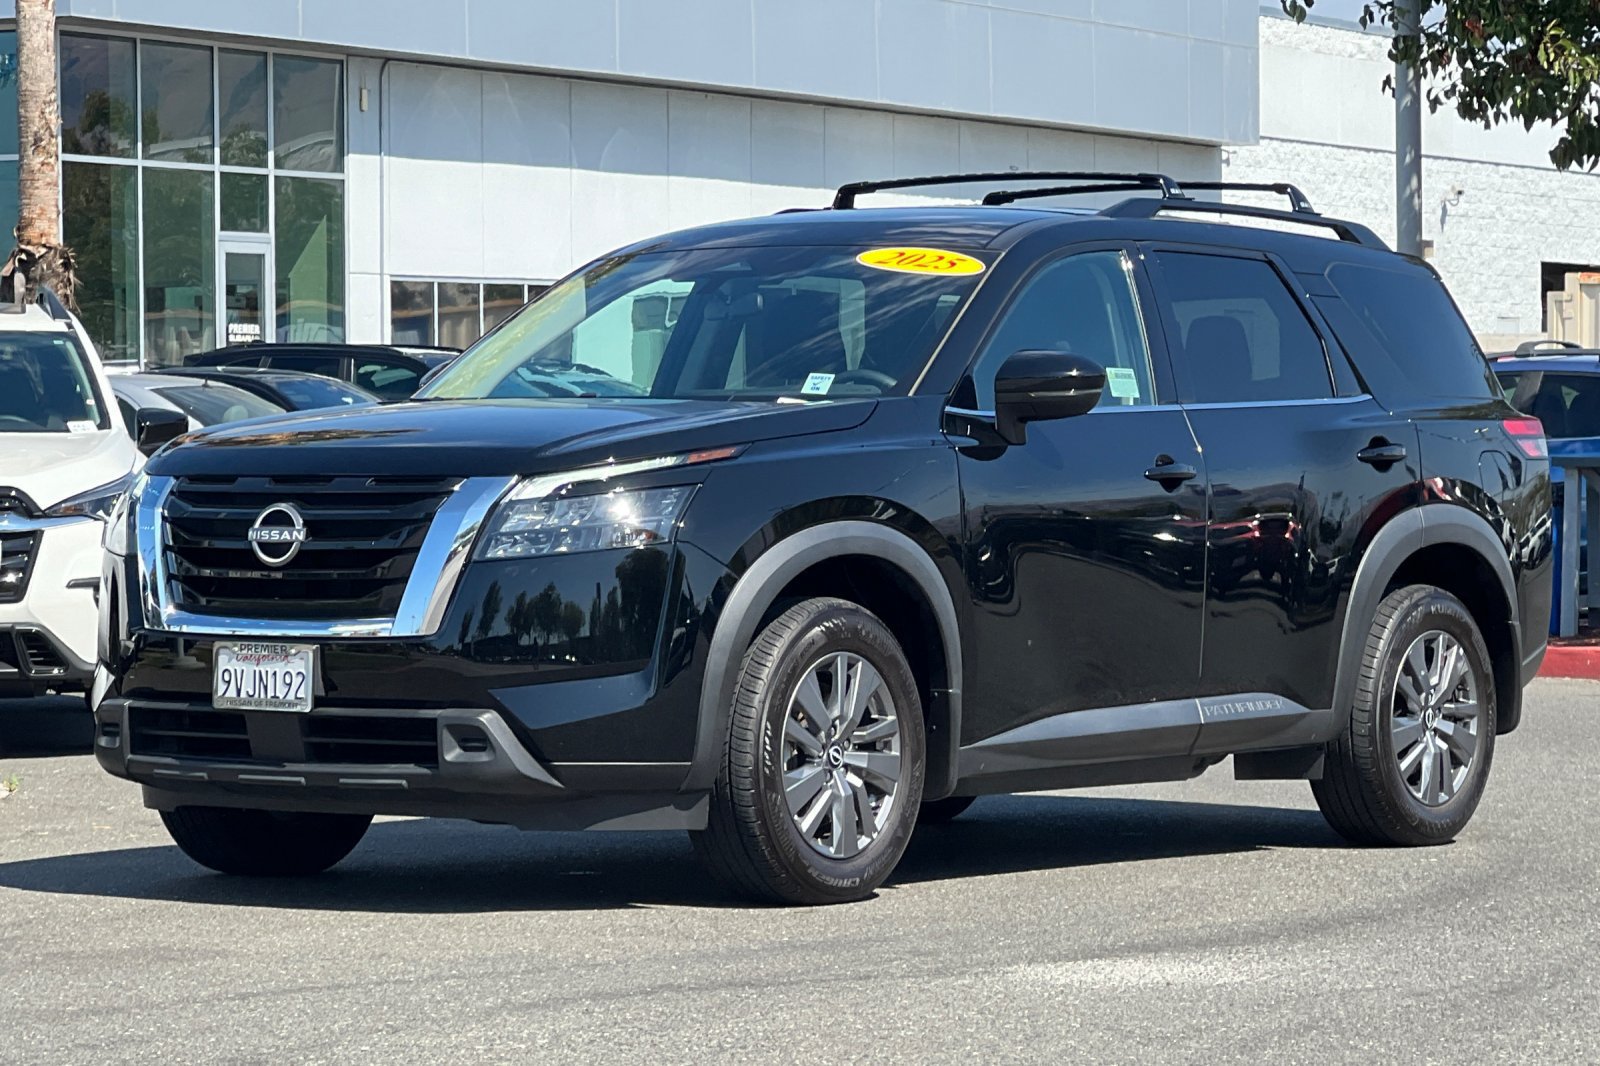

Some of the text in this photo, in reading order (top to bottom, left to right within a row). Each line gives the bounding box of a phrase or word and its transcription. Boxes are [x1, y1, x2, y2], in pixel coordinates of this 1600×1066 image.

[873, 251, 968, 270] 2025
[228, 323, 260, 334] PREMIER
[248, 529, 304, 540] NISSAN
[239, 643, 288, 655] PREMIER
[221, 668, 306, 700] 9VJN192
[225, 699, 253, 707] NISSAN
[265, 701, 299, 709] FREMONT
[1204, 699, 1285, 716] PATHFINDER
